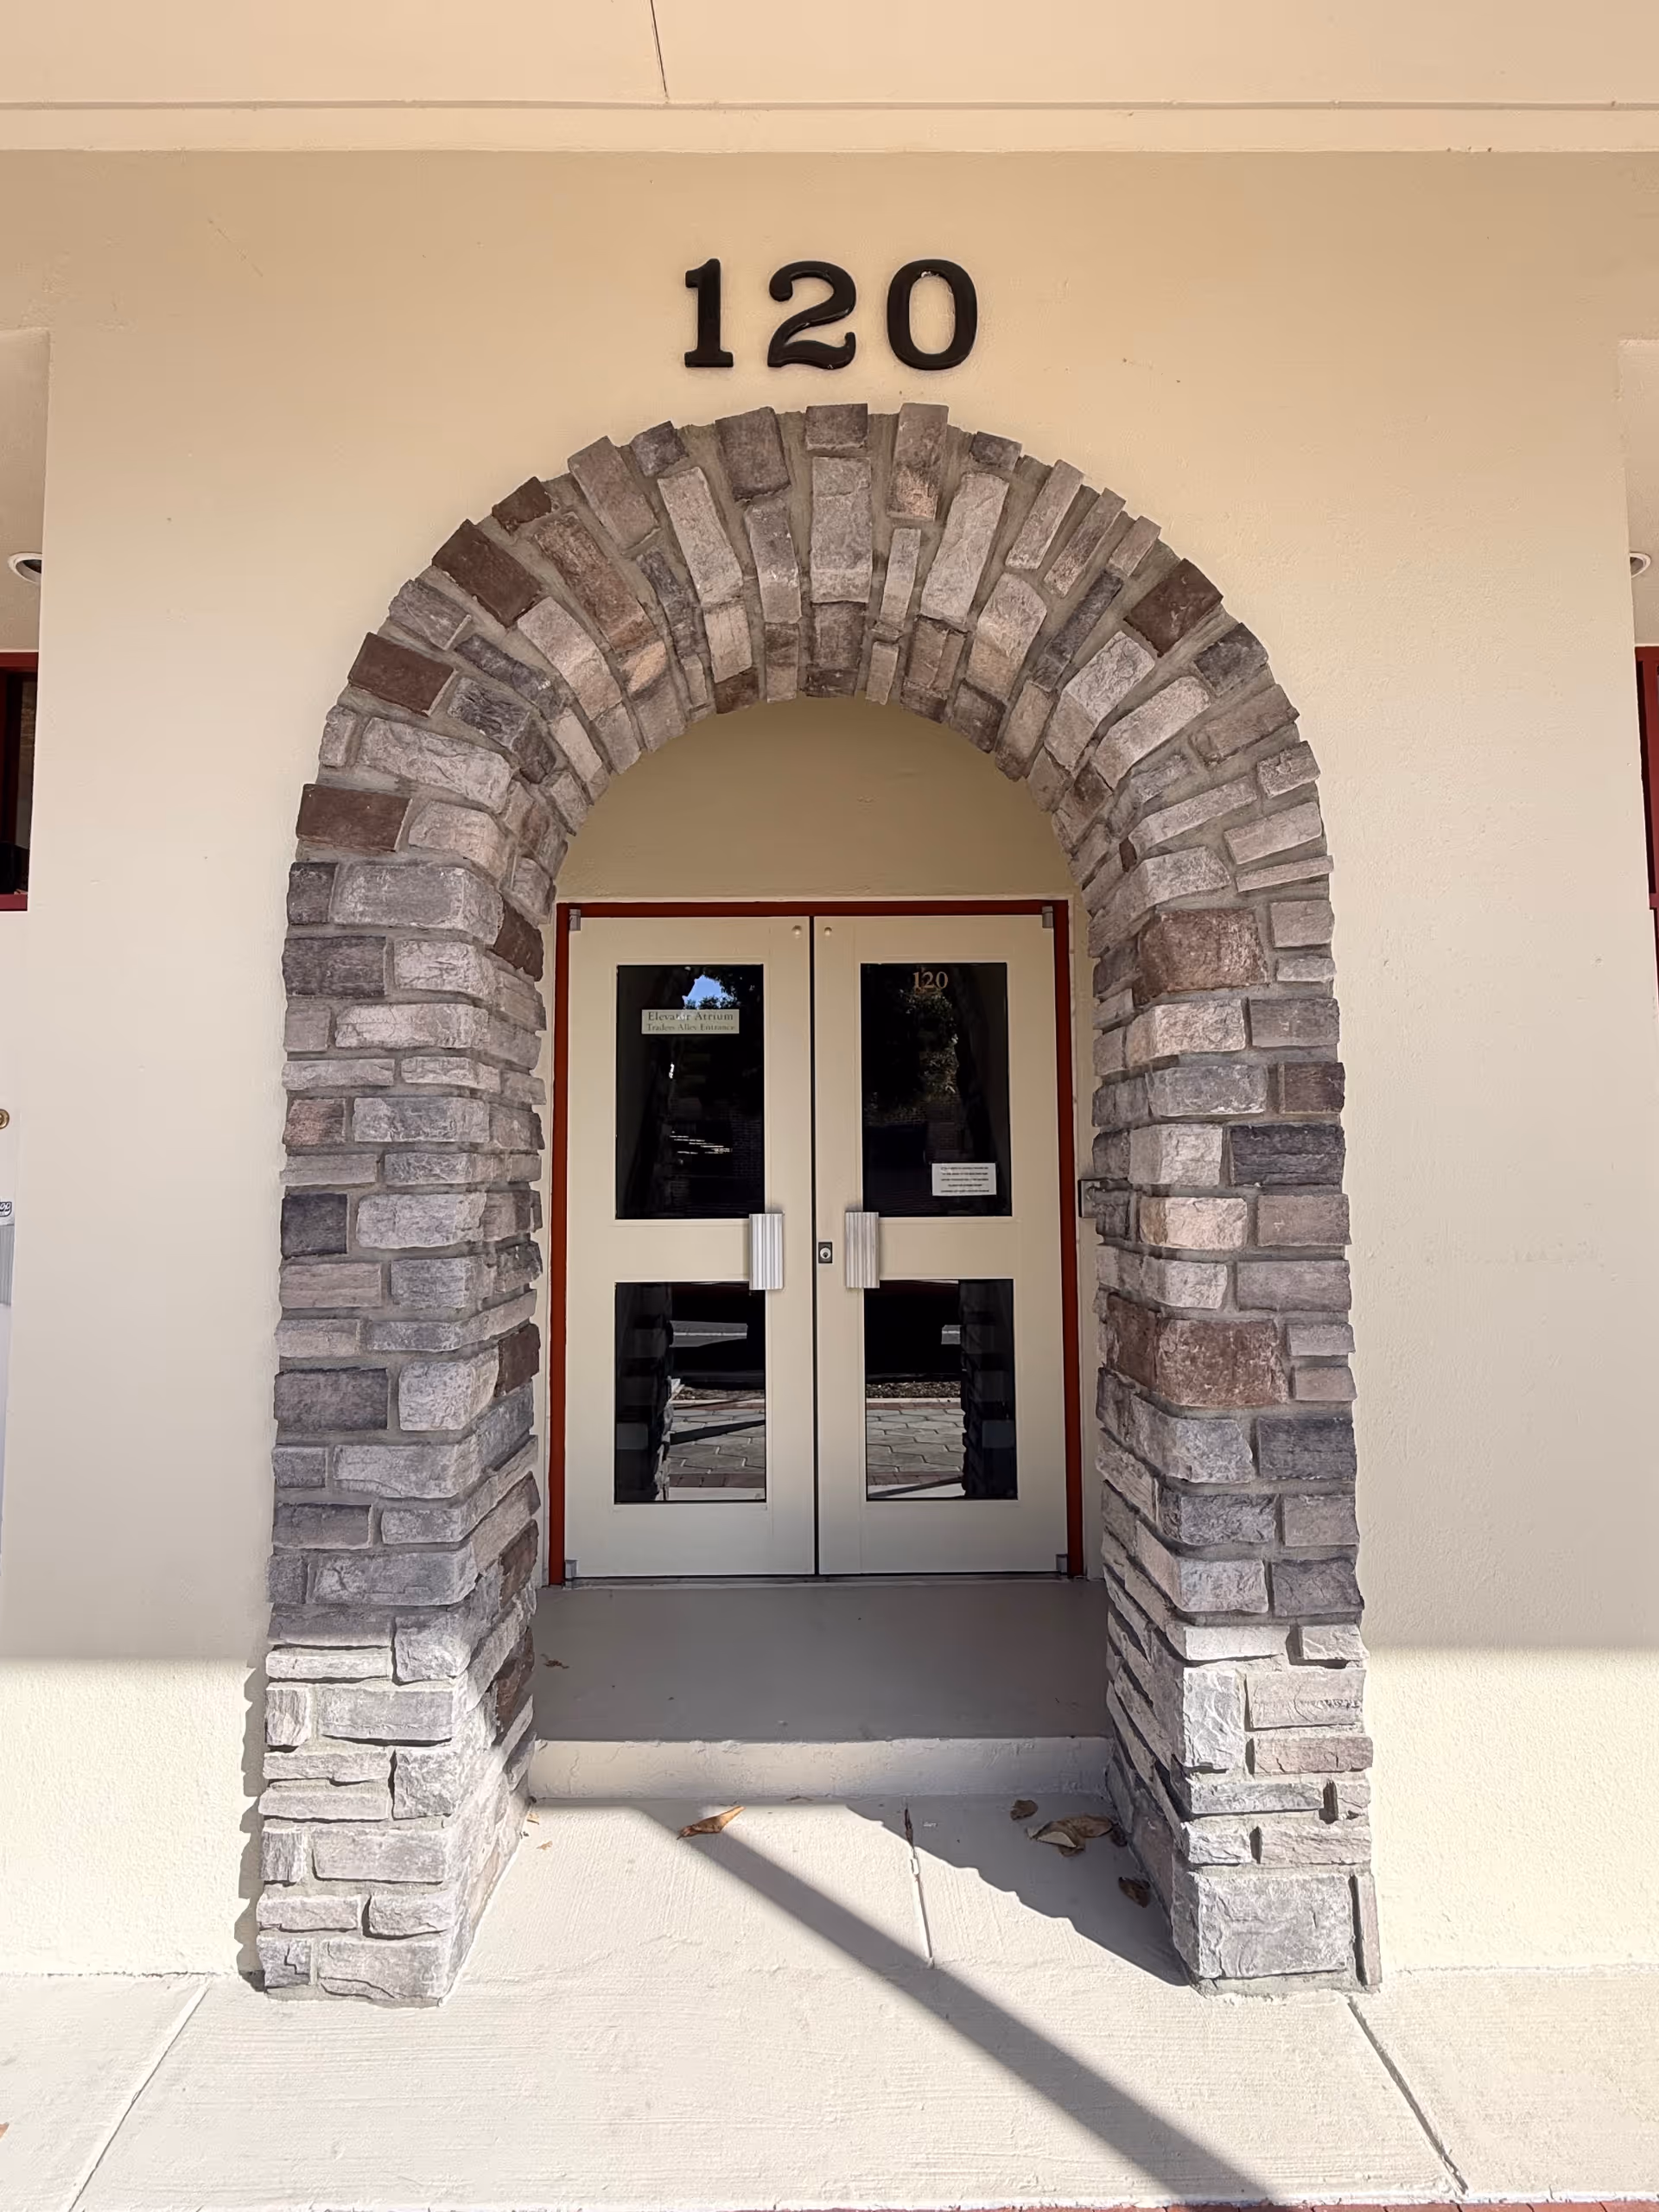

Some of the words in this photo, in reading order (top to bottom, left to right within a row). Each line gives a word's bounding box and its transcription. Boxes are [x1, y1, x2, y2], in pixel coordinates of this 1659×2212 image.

[684, 258, 977, 371] 120
[912, 971, 949, 989] 120
[695, 1011, 734, 1021] Atrium
[700, 1023, 735, 1032] Entrance
